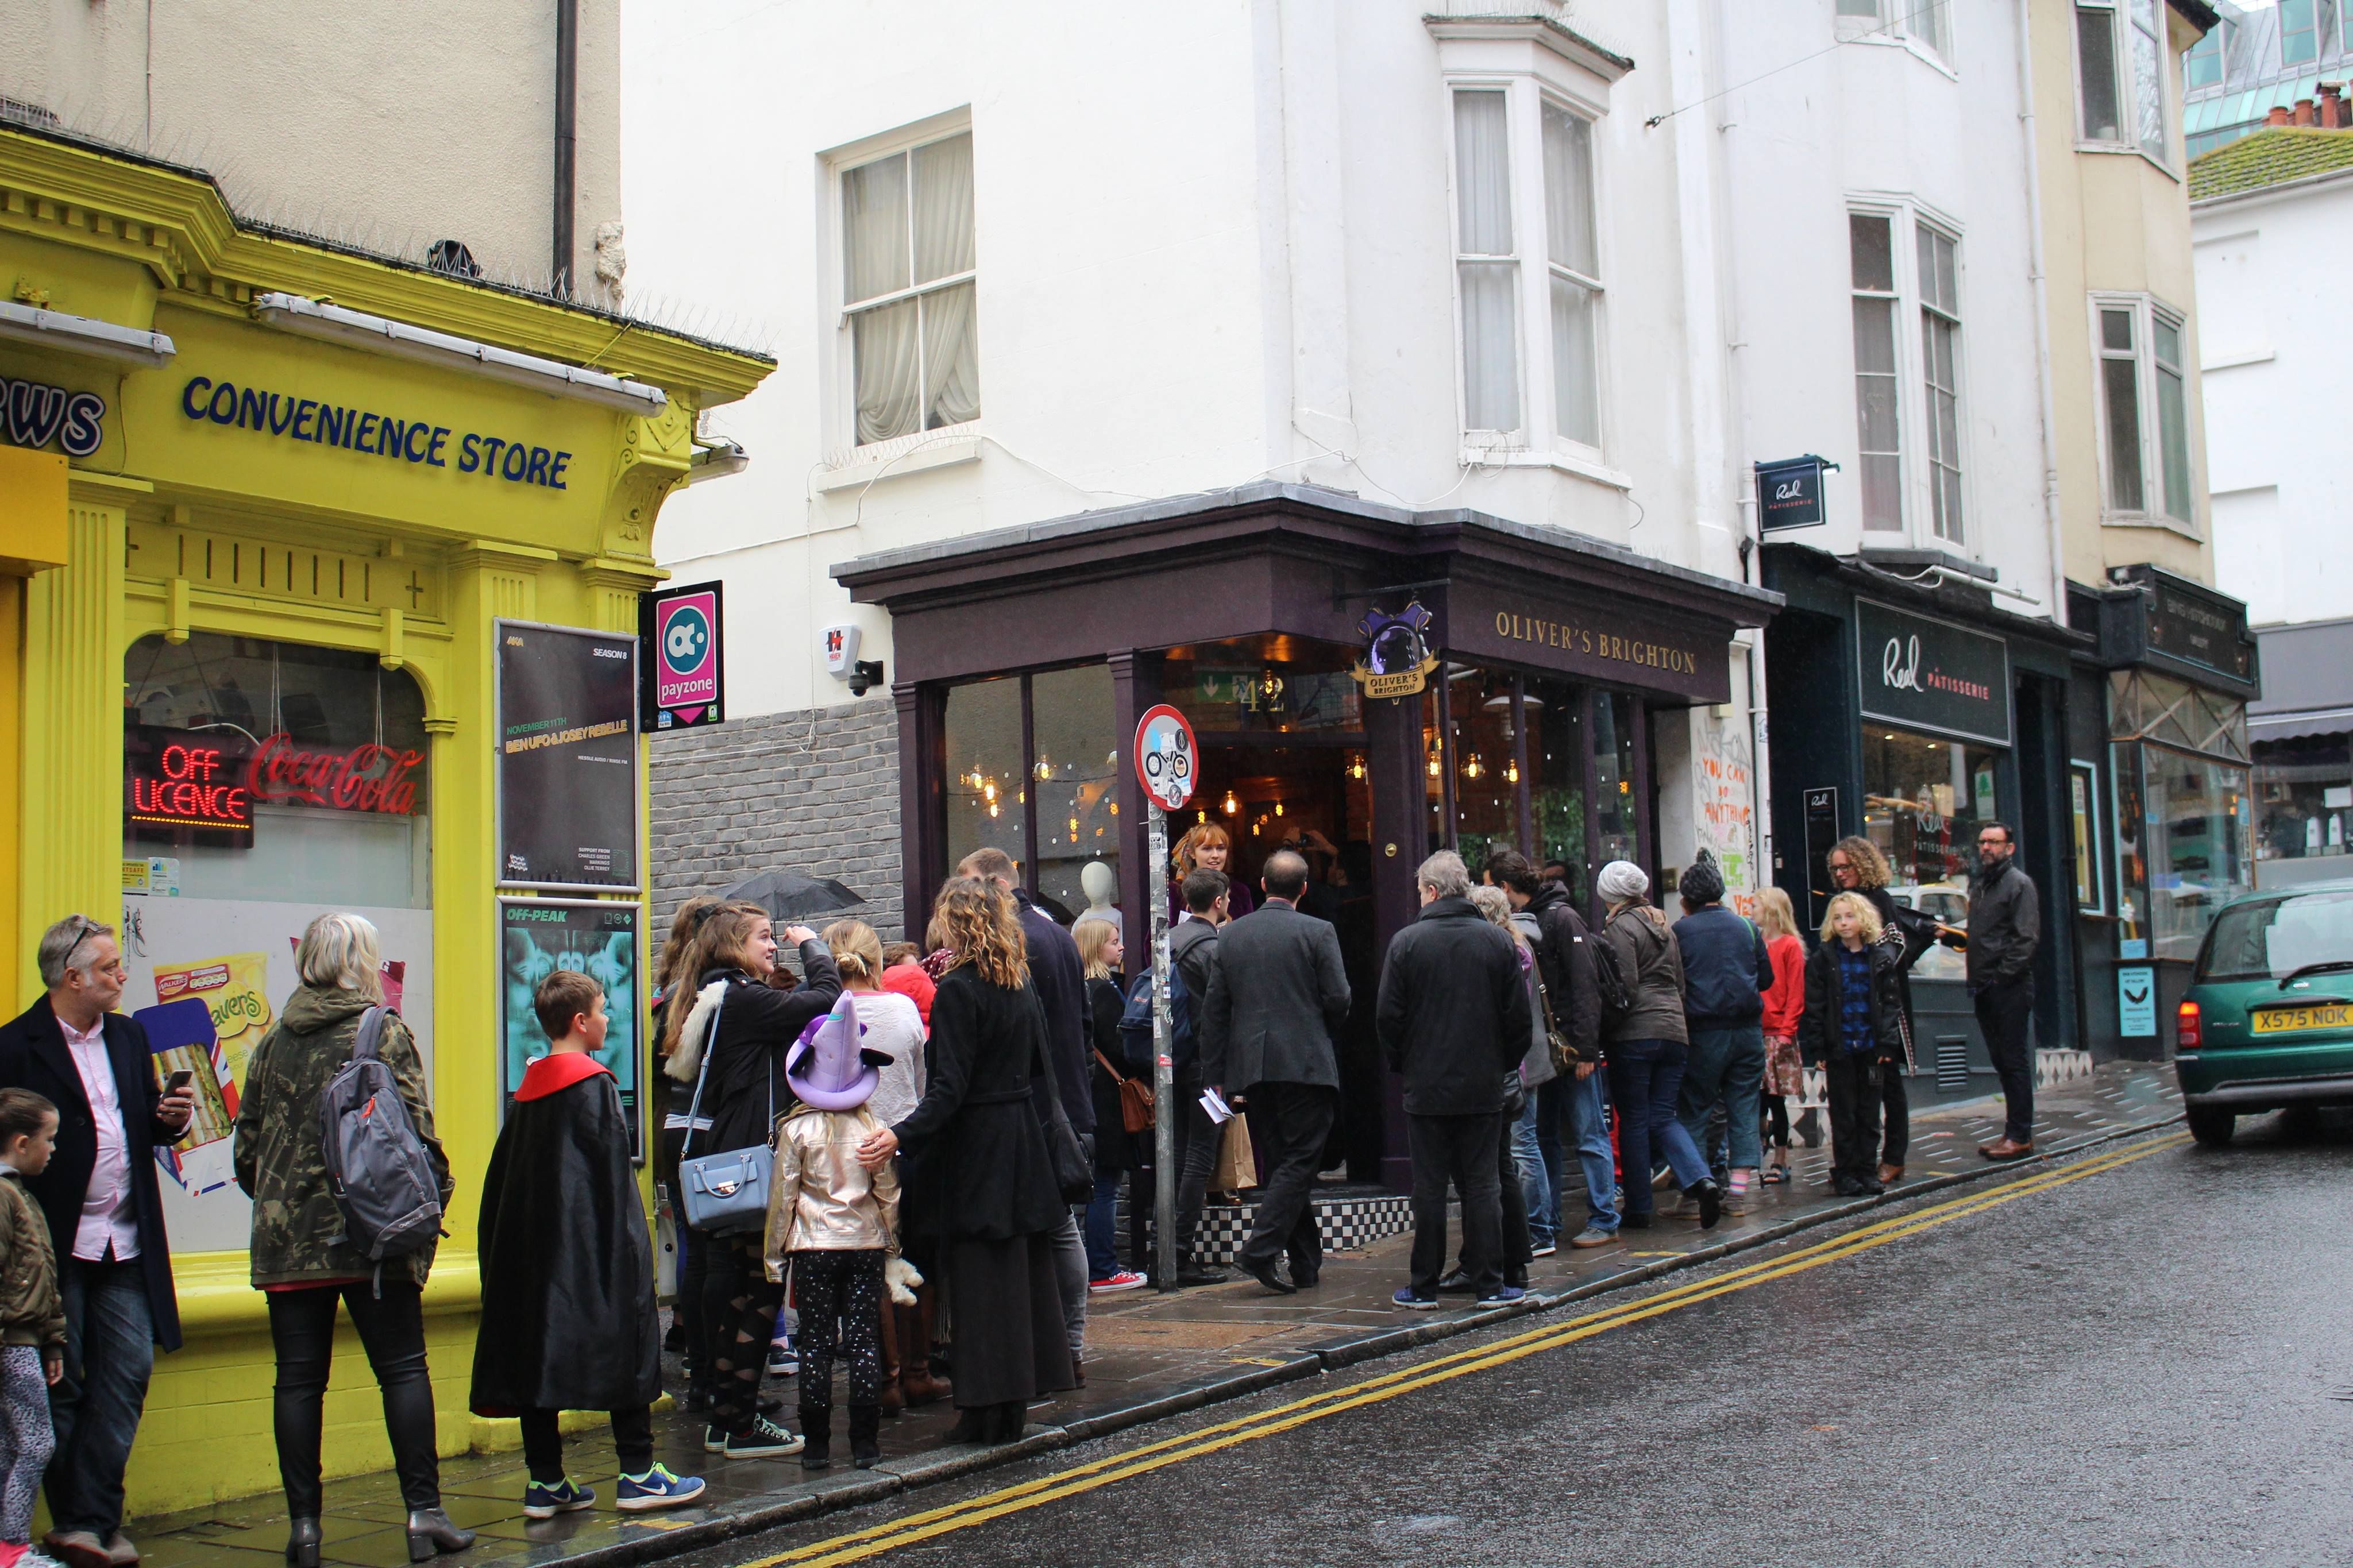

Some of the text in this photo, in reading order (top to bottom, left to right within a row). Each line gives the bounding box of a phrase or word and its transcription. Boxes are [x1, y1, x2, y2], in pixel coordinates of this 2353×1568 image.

[183, 376, 572, 490] CONVENIENCE STORE
[1776, 479, 1802, 500] Real
[593, 648, 623, 659] SEASON
[1496, 612, 1695, 675] OLIVER'S BRIGHTON
[1884, 634, 1924, 692] Real
[661, 678, 712, 701] payzone
[1370, 673, 1418, 687] OLIVER'S
[1374, 683, 1415, 694] BRIGHTON
[506, 737, 529, 754] BEN
[529, 733, 551, 750] UFO
[558, 727, 590, 744] JOSEY
[588, 719, 628, 737] REBELLE
[507, 717, 567, 735] NOVEMBER 11TH
[161, 744, 219, 781] OFF
[1702, 756, 1722, 779] YOU
[134, 778, 245, 820] LICENCE
[158, 976, 188, 991] WALKERS
[211, 991, 261, 1028] avers
[2261, 1007, 2348, 1029] X575 NOK
[227, 1049, 249, 1063] eese
